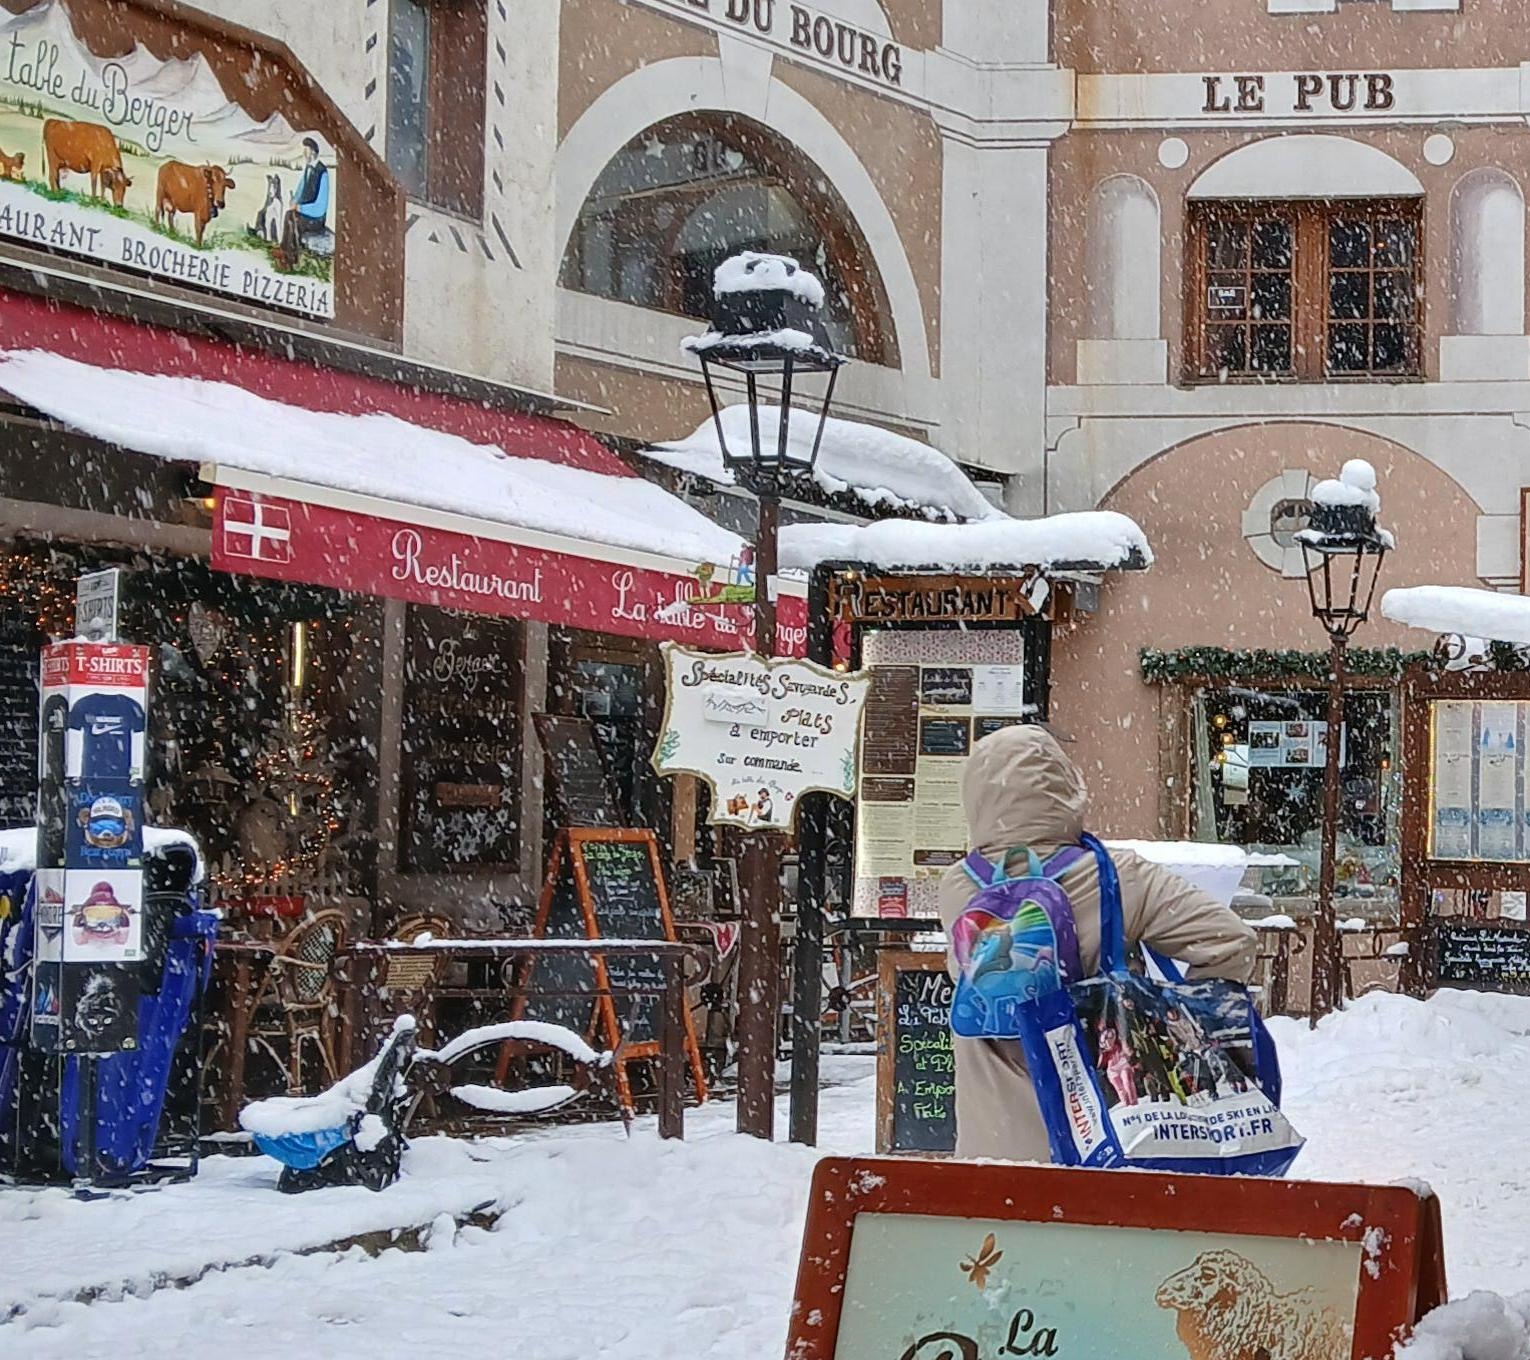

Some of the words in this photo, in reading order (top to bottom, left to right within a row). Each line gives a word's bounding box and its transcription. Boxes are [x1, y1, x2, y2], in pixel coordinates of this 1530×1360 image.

[790, 4, 903, 87] BOURG
[2, 31, 67, 99] table
[71, 81, 101, 111] du
[101, 62, 198, 153] Berger
[1202, 75, 1265, 113] LE
[1292, 73, 1395, 112] PUB
[0, 203, 102, 253] AURANT
[391, 527, 544, 605] Restaurant
[611, 570, 647, 622] La
[75, 656, 143, 675] T-SHIRTS
[750, 727, 819, 749] emporter
[1144, 1112, 1160, 1122] DE
[1161, 1111, 1173, 1121] LA
[1227, 1109, 1245, 1121] SKI
[1247, 1105, 1261, 1117] EN
[998, 1308, 1059, 1358] La
